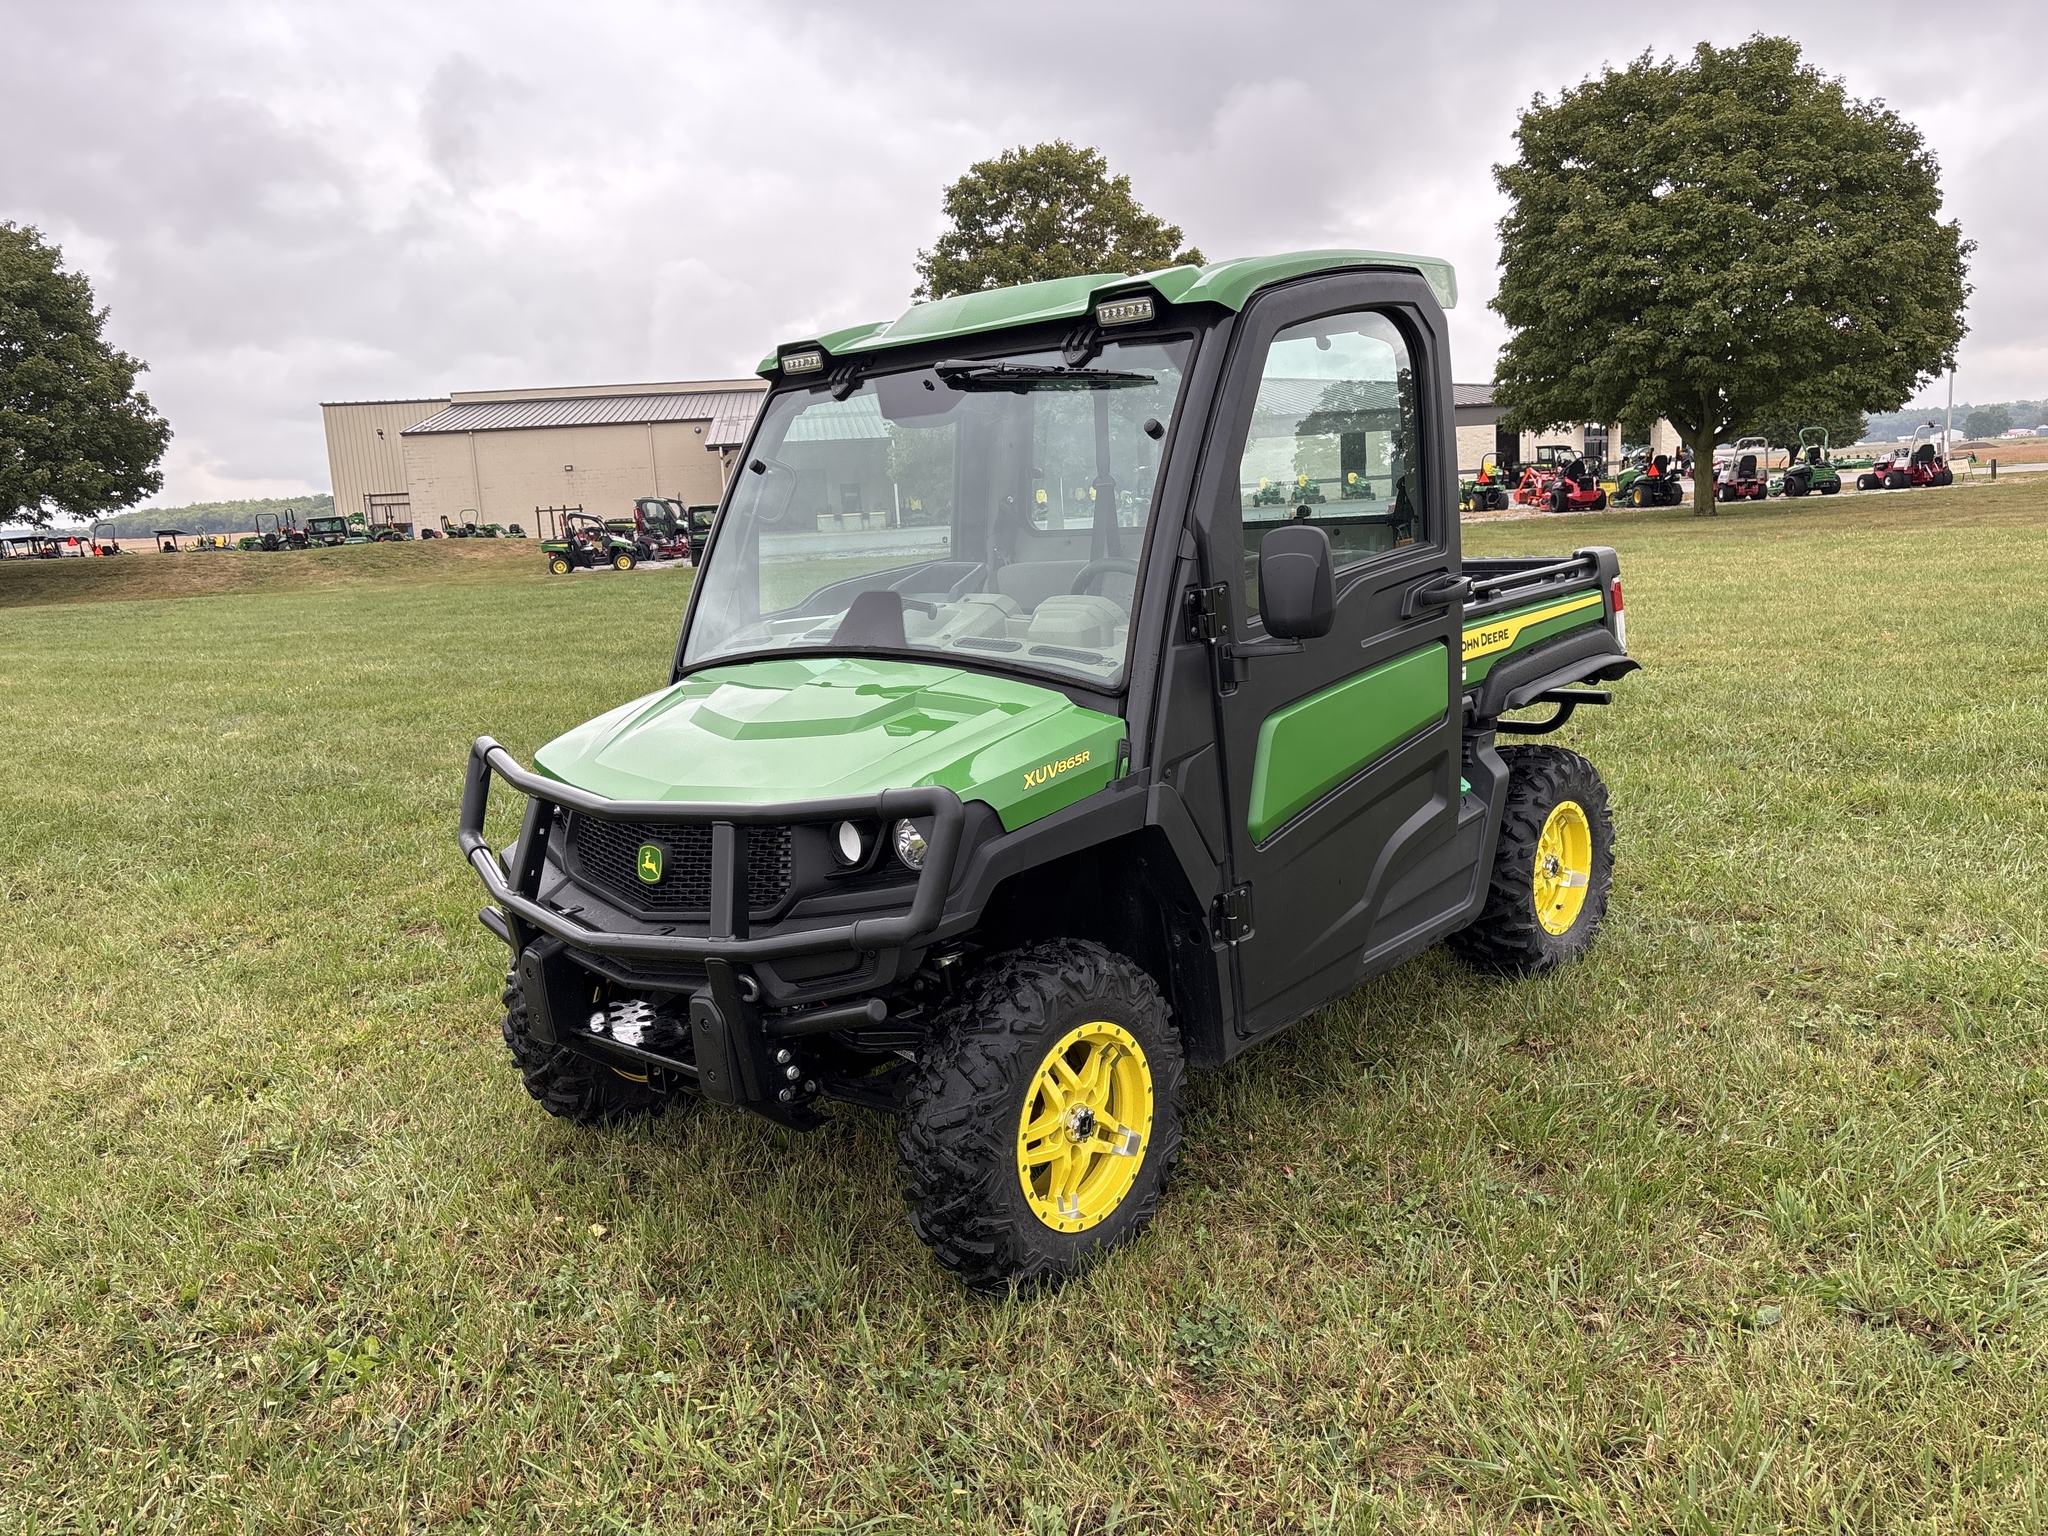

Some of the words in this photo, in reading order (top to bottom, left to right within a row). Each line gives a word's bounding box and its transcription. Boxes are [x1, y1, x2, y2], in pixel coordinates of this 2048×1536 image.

[1461, 637, 1480, 652] OHN
[1480, 628, 1509, 647] DEERE
[1022, 750, 1091, 791] XUV865R
